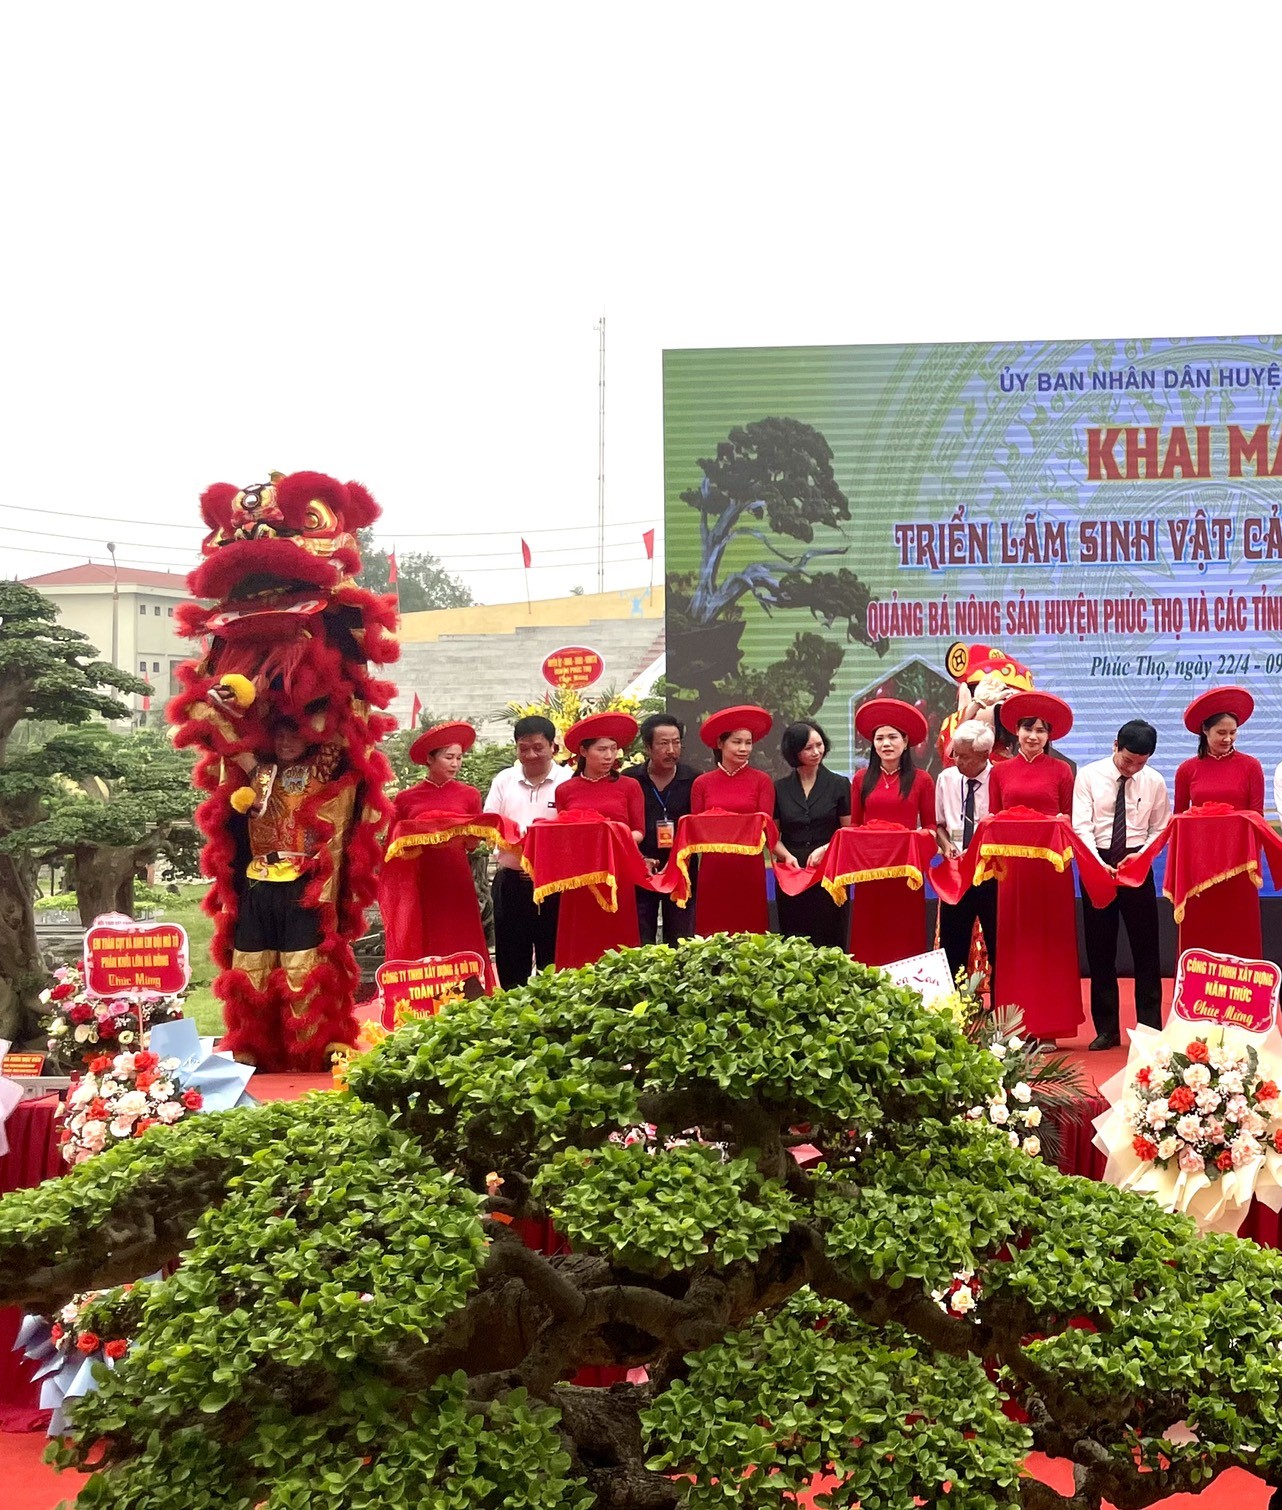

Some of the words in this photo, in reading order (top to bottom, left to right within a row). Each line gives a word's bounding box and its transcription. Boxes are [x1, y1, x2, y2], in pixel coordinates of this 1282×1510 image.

[1000, 366, 1028, 392] ỦY
[1038, 372, 1084, 391] BAN
[1092, 366, 1155, 390] NHÂN
[1164, 365, 1211, 389] DÂN
[1087, 426, 1212, 480] KHAI
[895, 505, 990, 570] TRIỂN
[1001, 512, 1068, 564] LÃM
[1079, 520, 1157, 562] SINH
[1167, 509, 1232, 571] VẬT
[868, 590, 923, 641] QUẢNG
[928, 594, 950, 635] BÁ
[956, 593, 1001, 635] NÔNG
[1006, 589, 1039, 635] SẢN
[1045, 592, 1098, 641] HUYỆN
[1103, 591, 1147, 634] PHÚC
[1152, 597, 1183, 640] THỌ
[1187, 590, 1210, 632] VÀ
[1214, 589, 1247, 632] CÁC
[1090, 655, 1131, 676] Phúc
[1136, 655, 1170, 681] Thọ,
[1174, 655, 1212, 681] ngày
[1217, 654, 1251, 675] 22/4
[399, 970, 407, 982] TY
[1186, 957, 1207, 975] CÔNG
[1208, 962, 1217, 976] TY
[1218, 964, 1238, 980] TNHH
[1238, 966, 1253, 983] XÂY
[1253, 970, 1274, 988] DỰNG
[409, 983, 434, 1000] TOÀN
[1205, 980, 1227, 998] NĂM
[1229, 985, 1253, 1003] THỨC
[1193, 999, 1220, 1018] Chúc
[1222, 1005, 1254, 1027] Mừng
